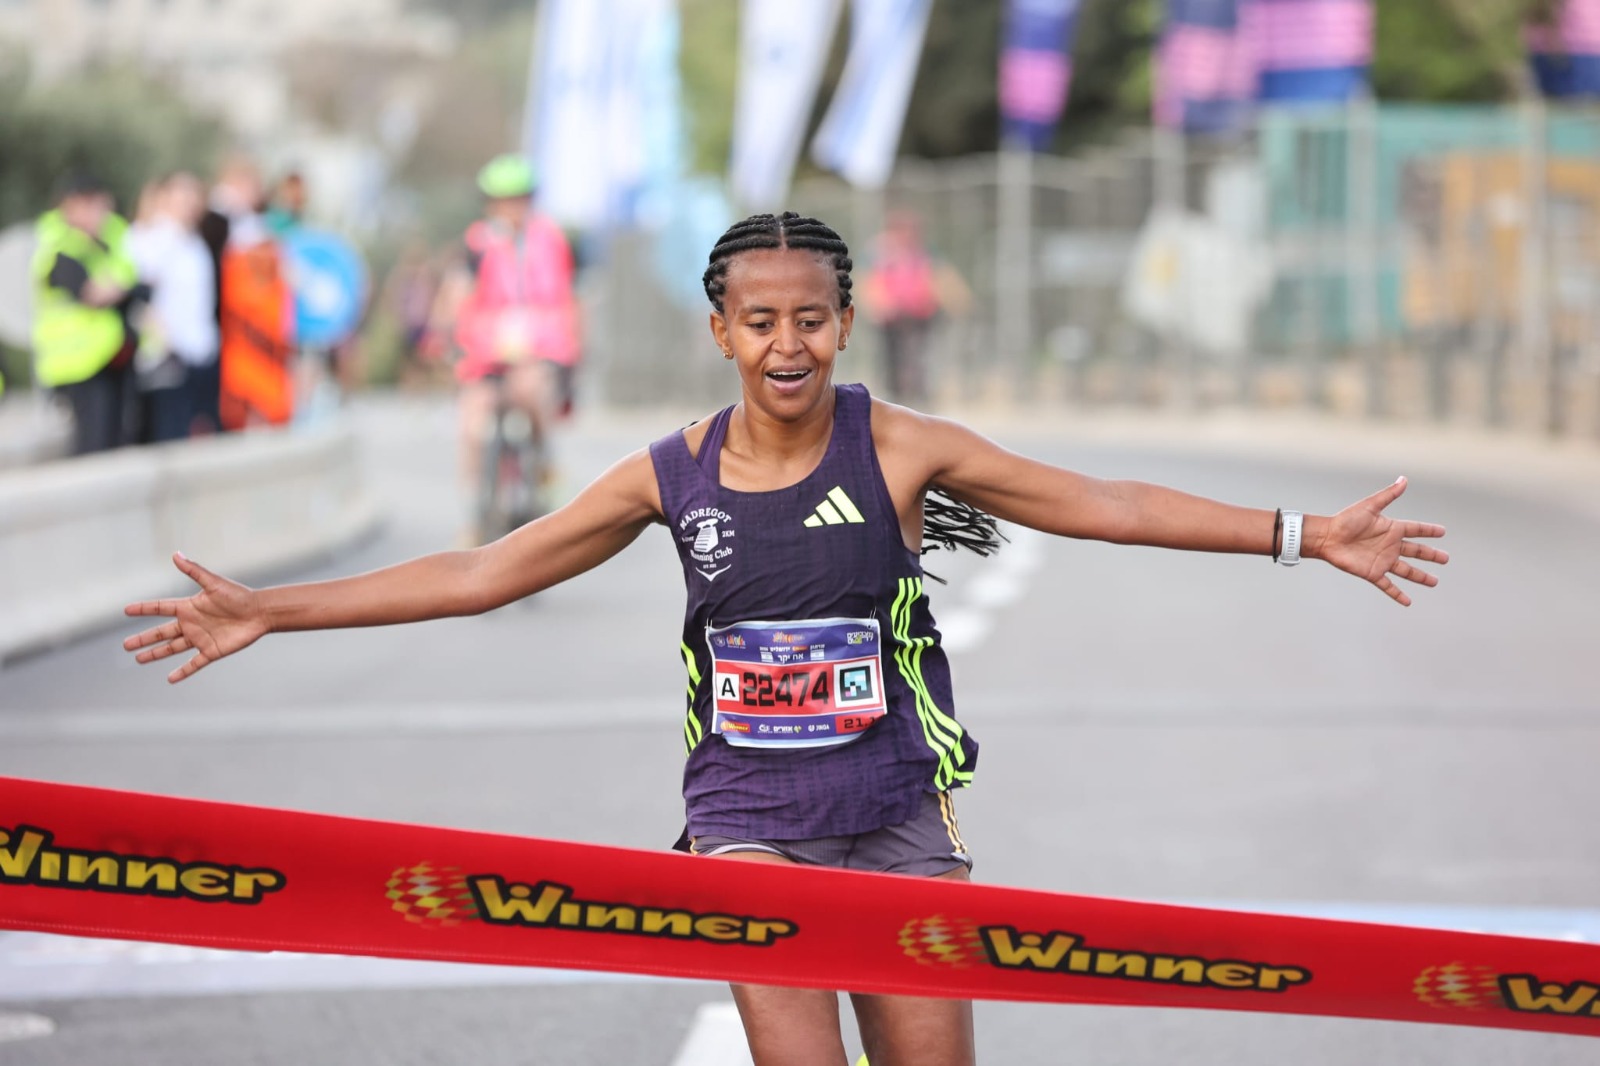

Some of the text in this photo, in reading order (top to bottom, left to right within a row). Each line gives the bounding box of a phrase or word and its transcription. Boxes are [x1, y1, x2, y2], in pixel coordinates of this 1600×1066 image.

[680, 507, 732, 530] MADREGOT
[714, 546, 733, 559] Club
[721, 677, 736, 698] A
[743, 672, 829, 707] 22474
[469, 875, 796, 944] Winner
[981, 927, 1309, 989] Winner
